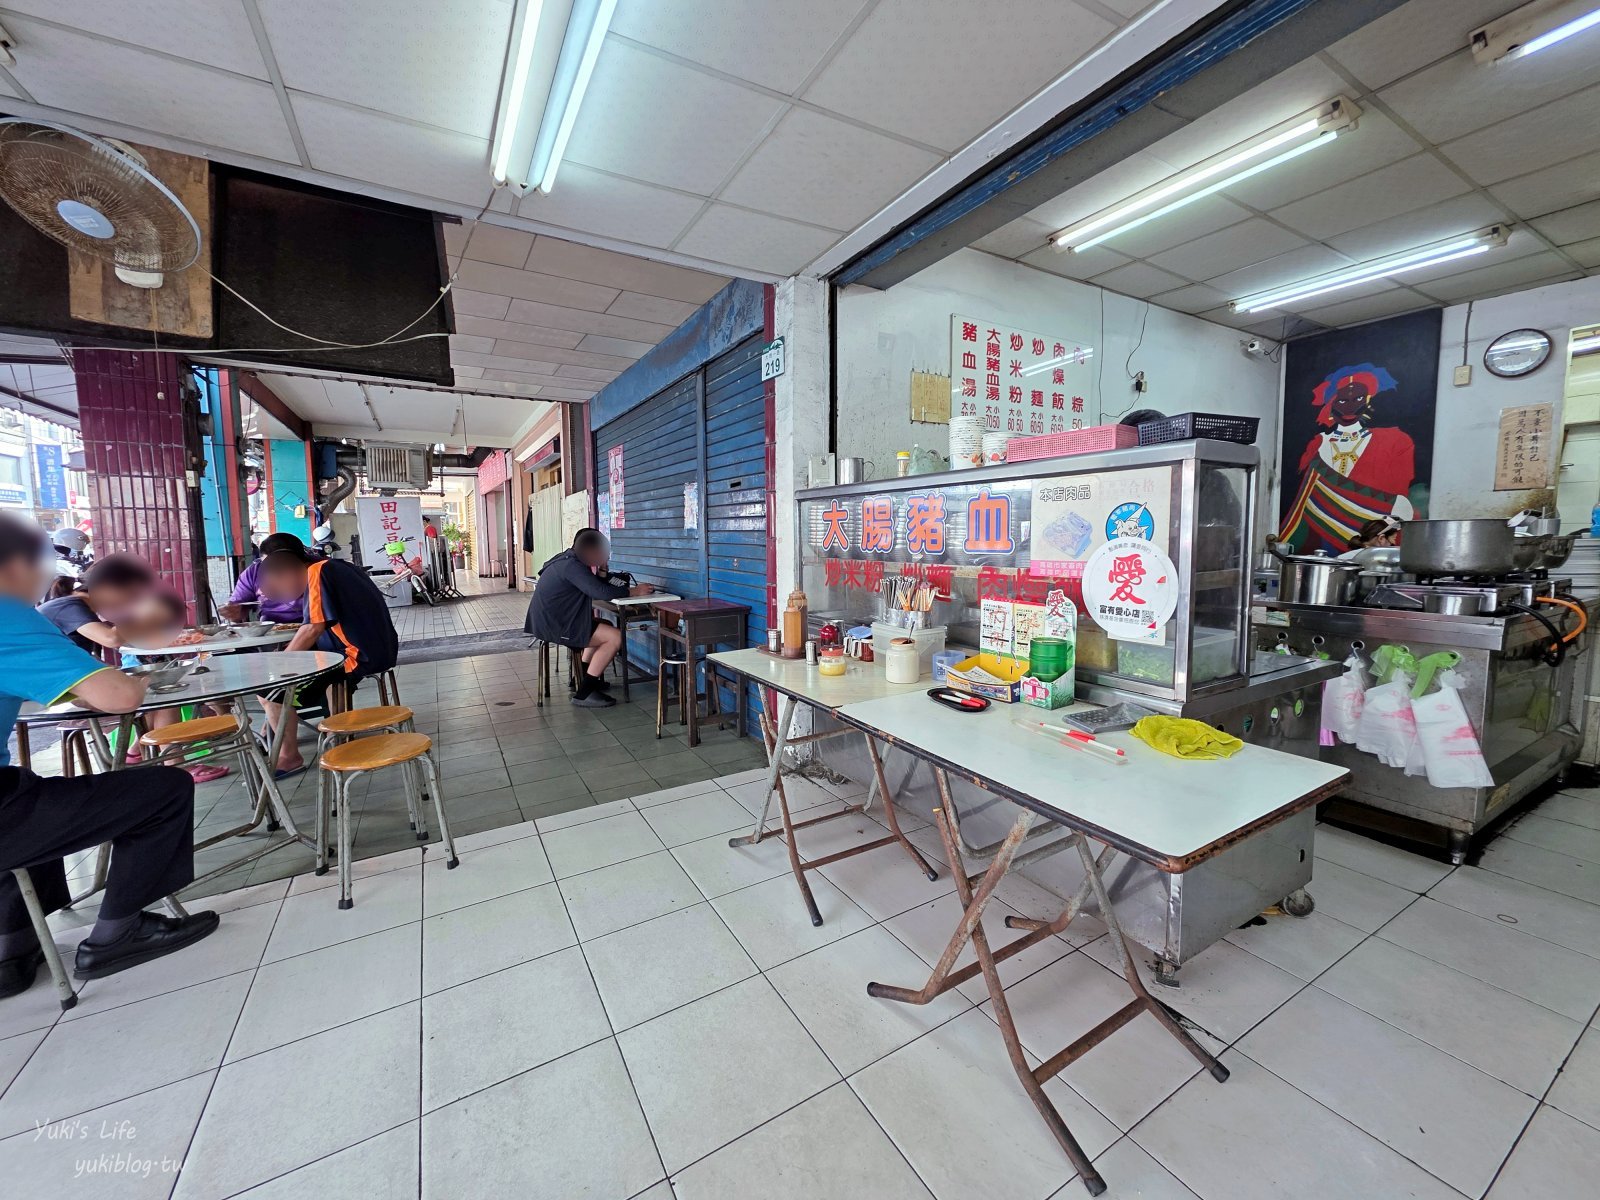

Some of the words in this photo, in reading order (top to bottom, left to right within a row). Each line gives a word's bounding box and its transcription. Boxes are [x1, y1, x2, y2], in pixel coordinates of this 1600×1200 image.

[765, 358, 780, 377] 219
[962, 321, 977, 397] 豬血湯
[985, 328, 1001, 401] 大腸豬血湯
[1008, 333, 1023, 403] 炒米粉
[1031, 337, 1045, 408] 炒麵
[1052, 342, 1065, 411] 肉燥飯
[1072, 418, 1083, 430] 50
[821, 487, 1015, 555] 大腸豬血
[1039, 484, 1091, 502] 本店肉品
[825, 557, 884, 593] 炒米粉
[1099, 604, 1141, 619] 富有愛心店
